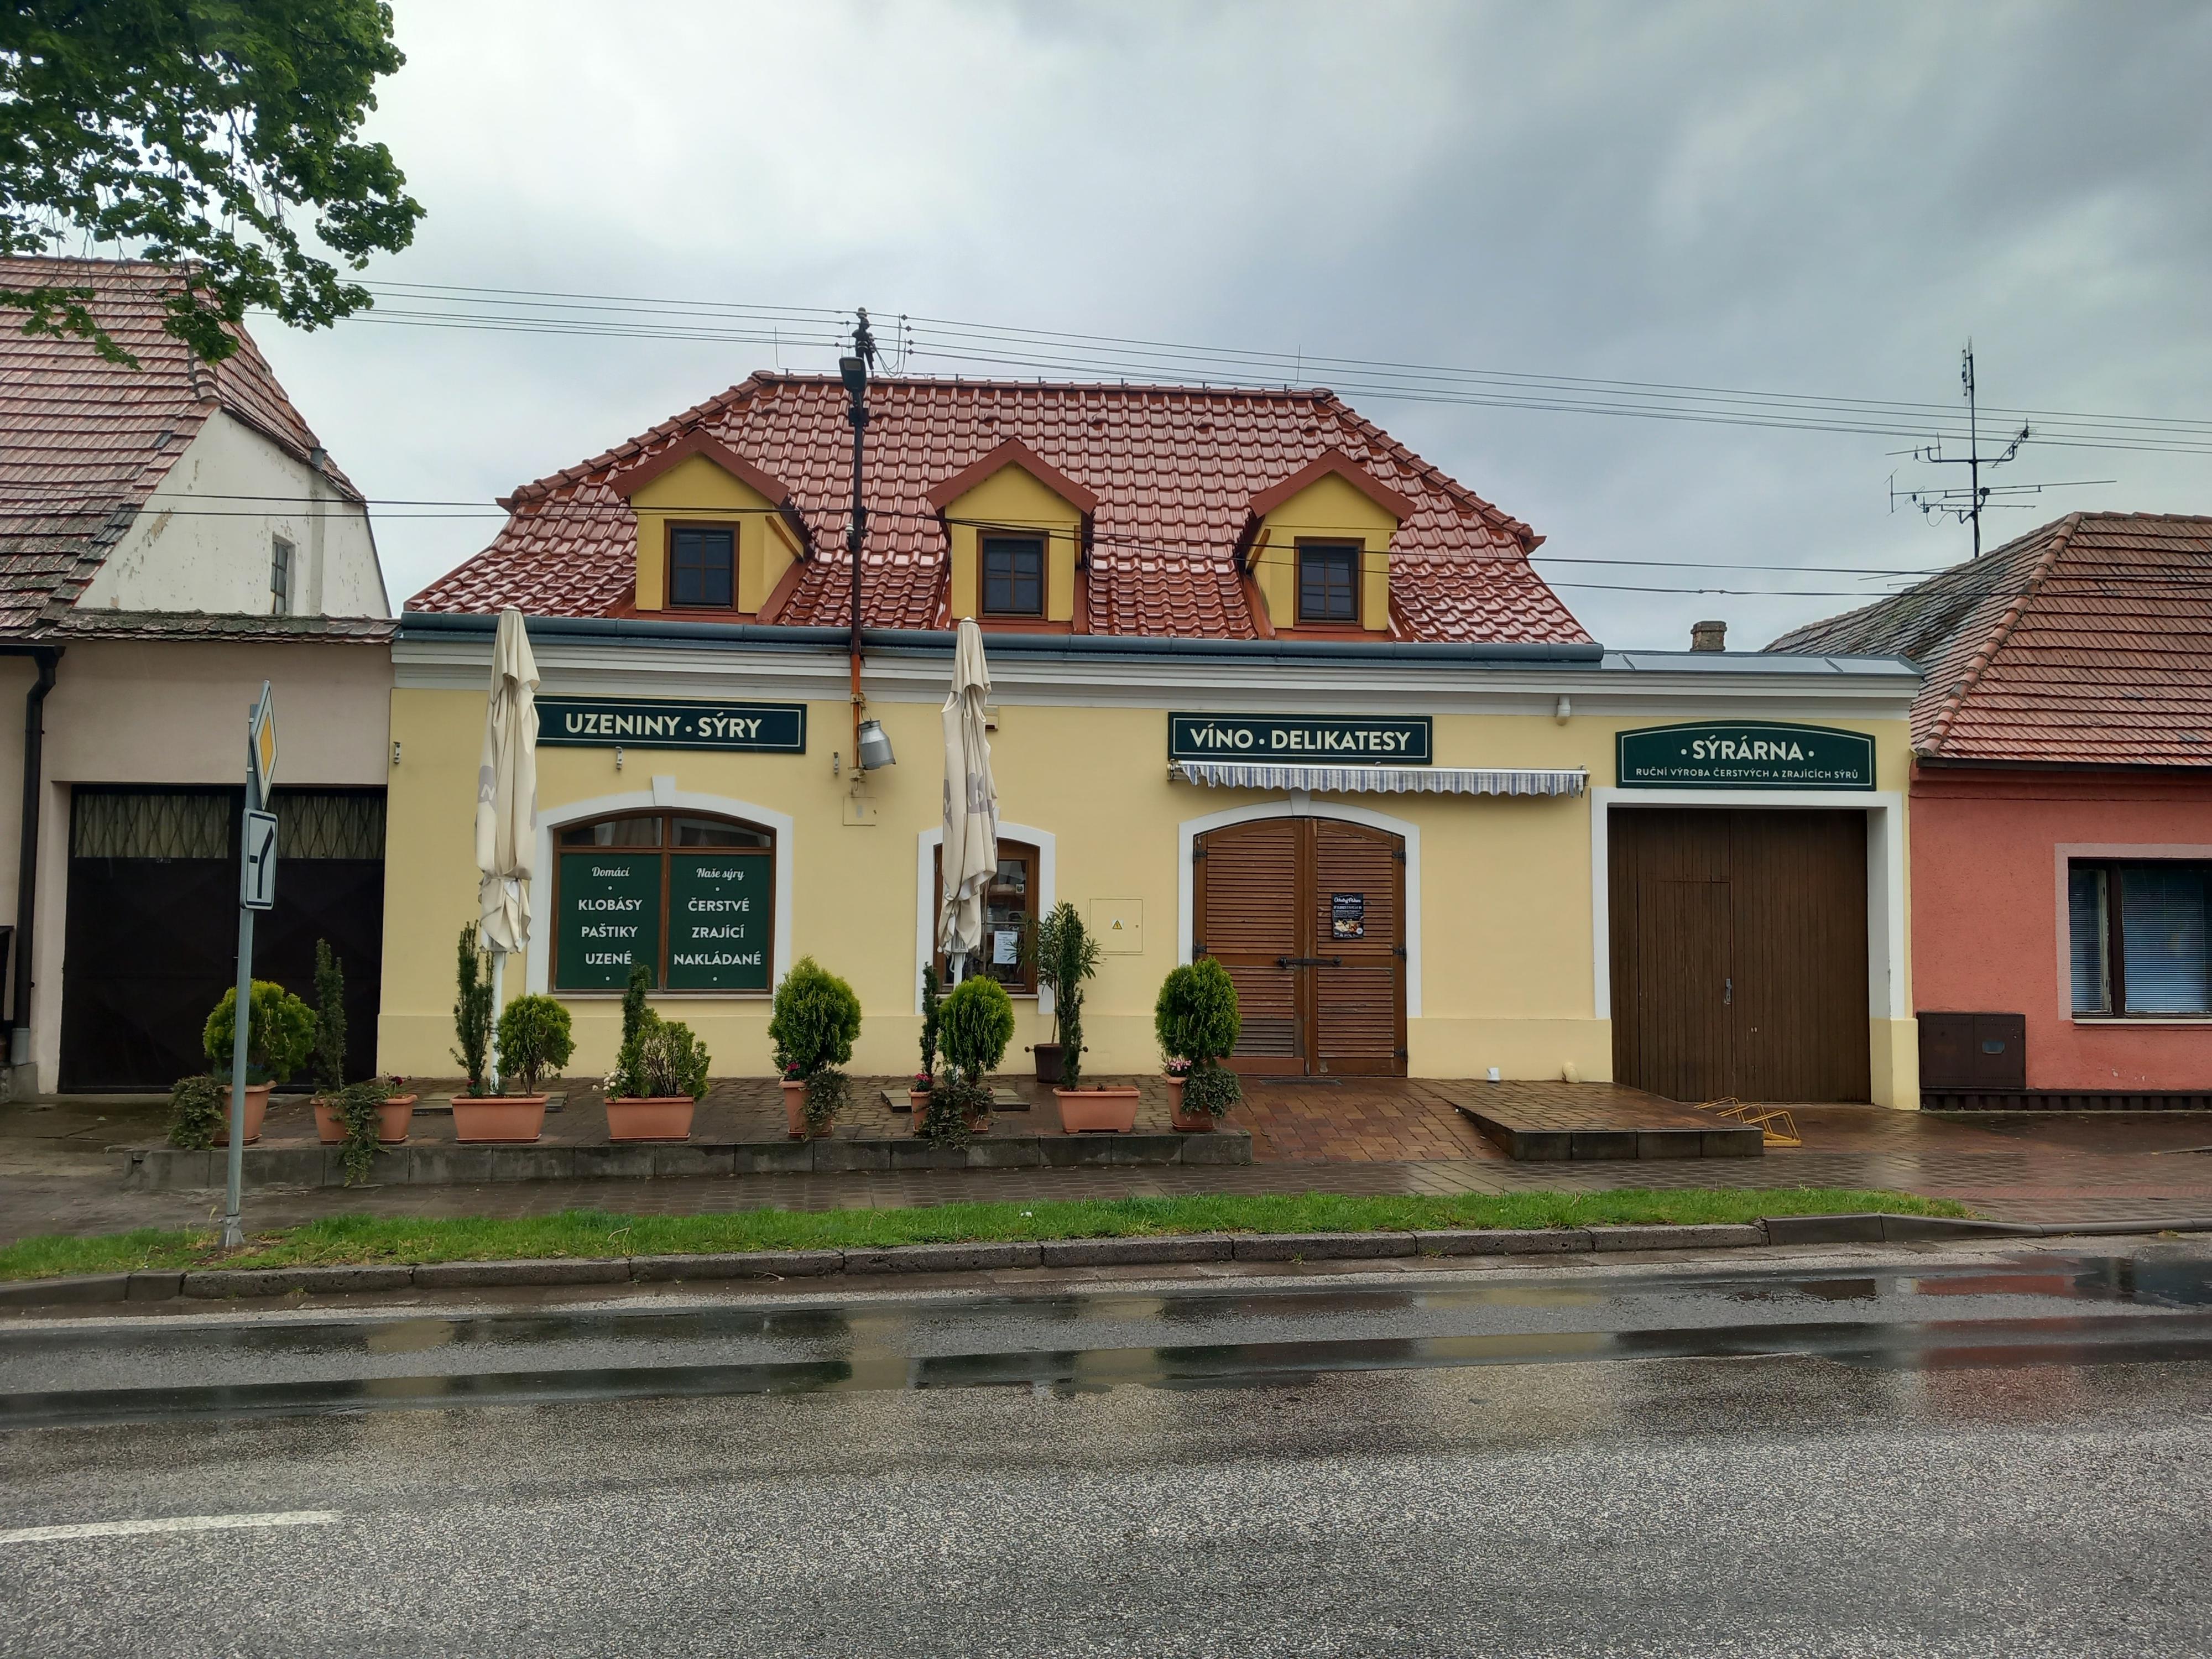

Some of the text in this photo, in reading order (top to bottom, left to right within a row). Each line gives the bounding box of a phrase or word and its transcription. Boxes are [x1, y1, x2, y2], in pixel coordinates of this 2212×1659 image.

[566, 712, 762, 738] UZENINY SÝRY
[1190, 723, 1411, 750] VÍNO DELIKATESY
[1692, 734, 1804, 761] SÝRÁRNA
[1636, 766, 1667, 776] RUČNÍ
[1670, 767, 1710, 776] VÝROBA
[1713, 767, 1769, 778] ČERSTVÝCH
[1782, 769, 1831, 779] ZRAJÍCÍCH
[1834, 769, 1858, 779] SÝRŮ
[592, 867, 630, 877] Domácí
[696, 868, 744, 881] Naše sýry
[578, 896, 643, 911] KLOBÁSY
[688, 897, 749, 911] ČERSTVÉ
[581, 923, 638, 937] PAŠTIKY
[692, 924, 745, 938] ZRAJÍCÍ
[586, 950, 632, 964] UZENÉ
[674, 951, 761, 965] NAKLÁDANÉ
